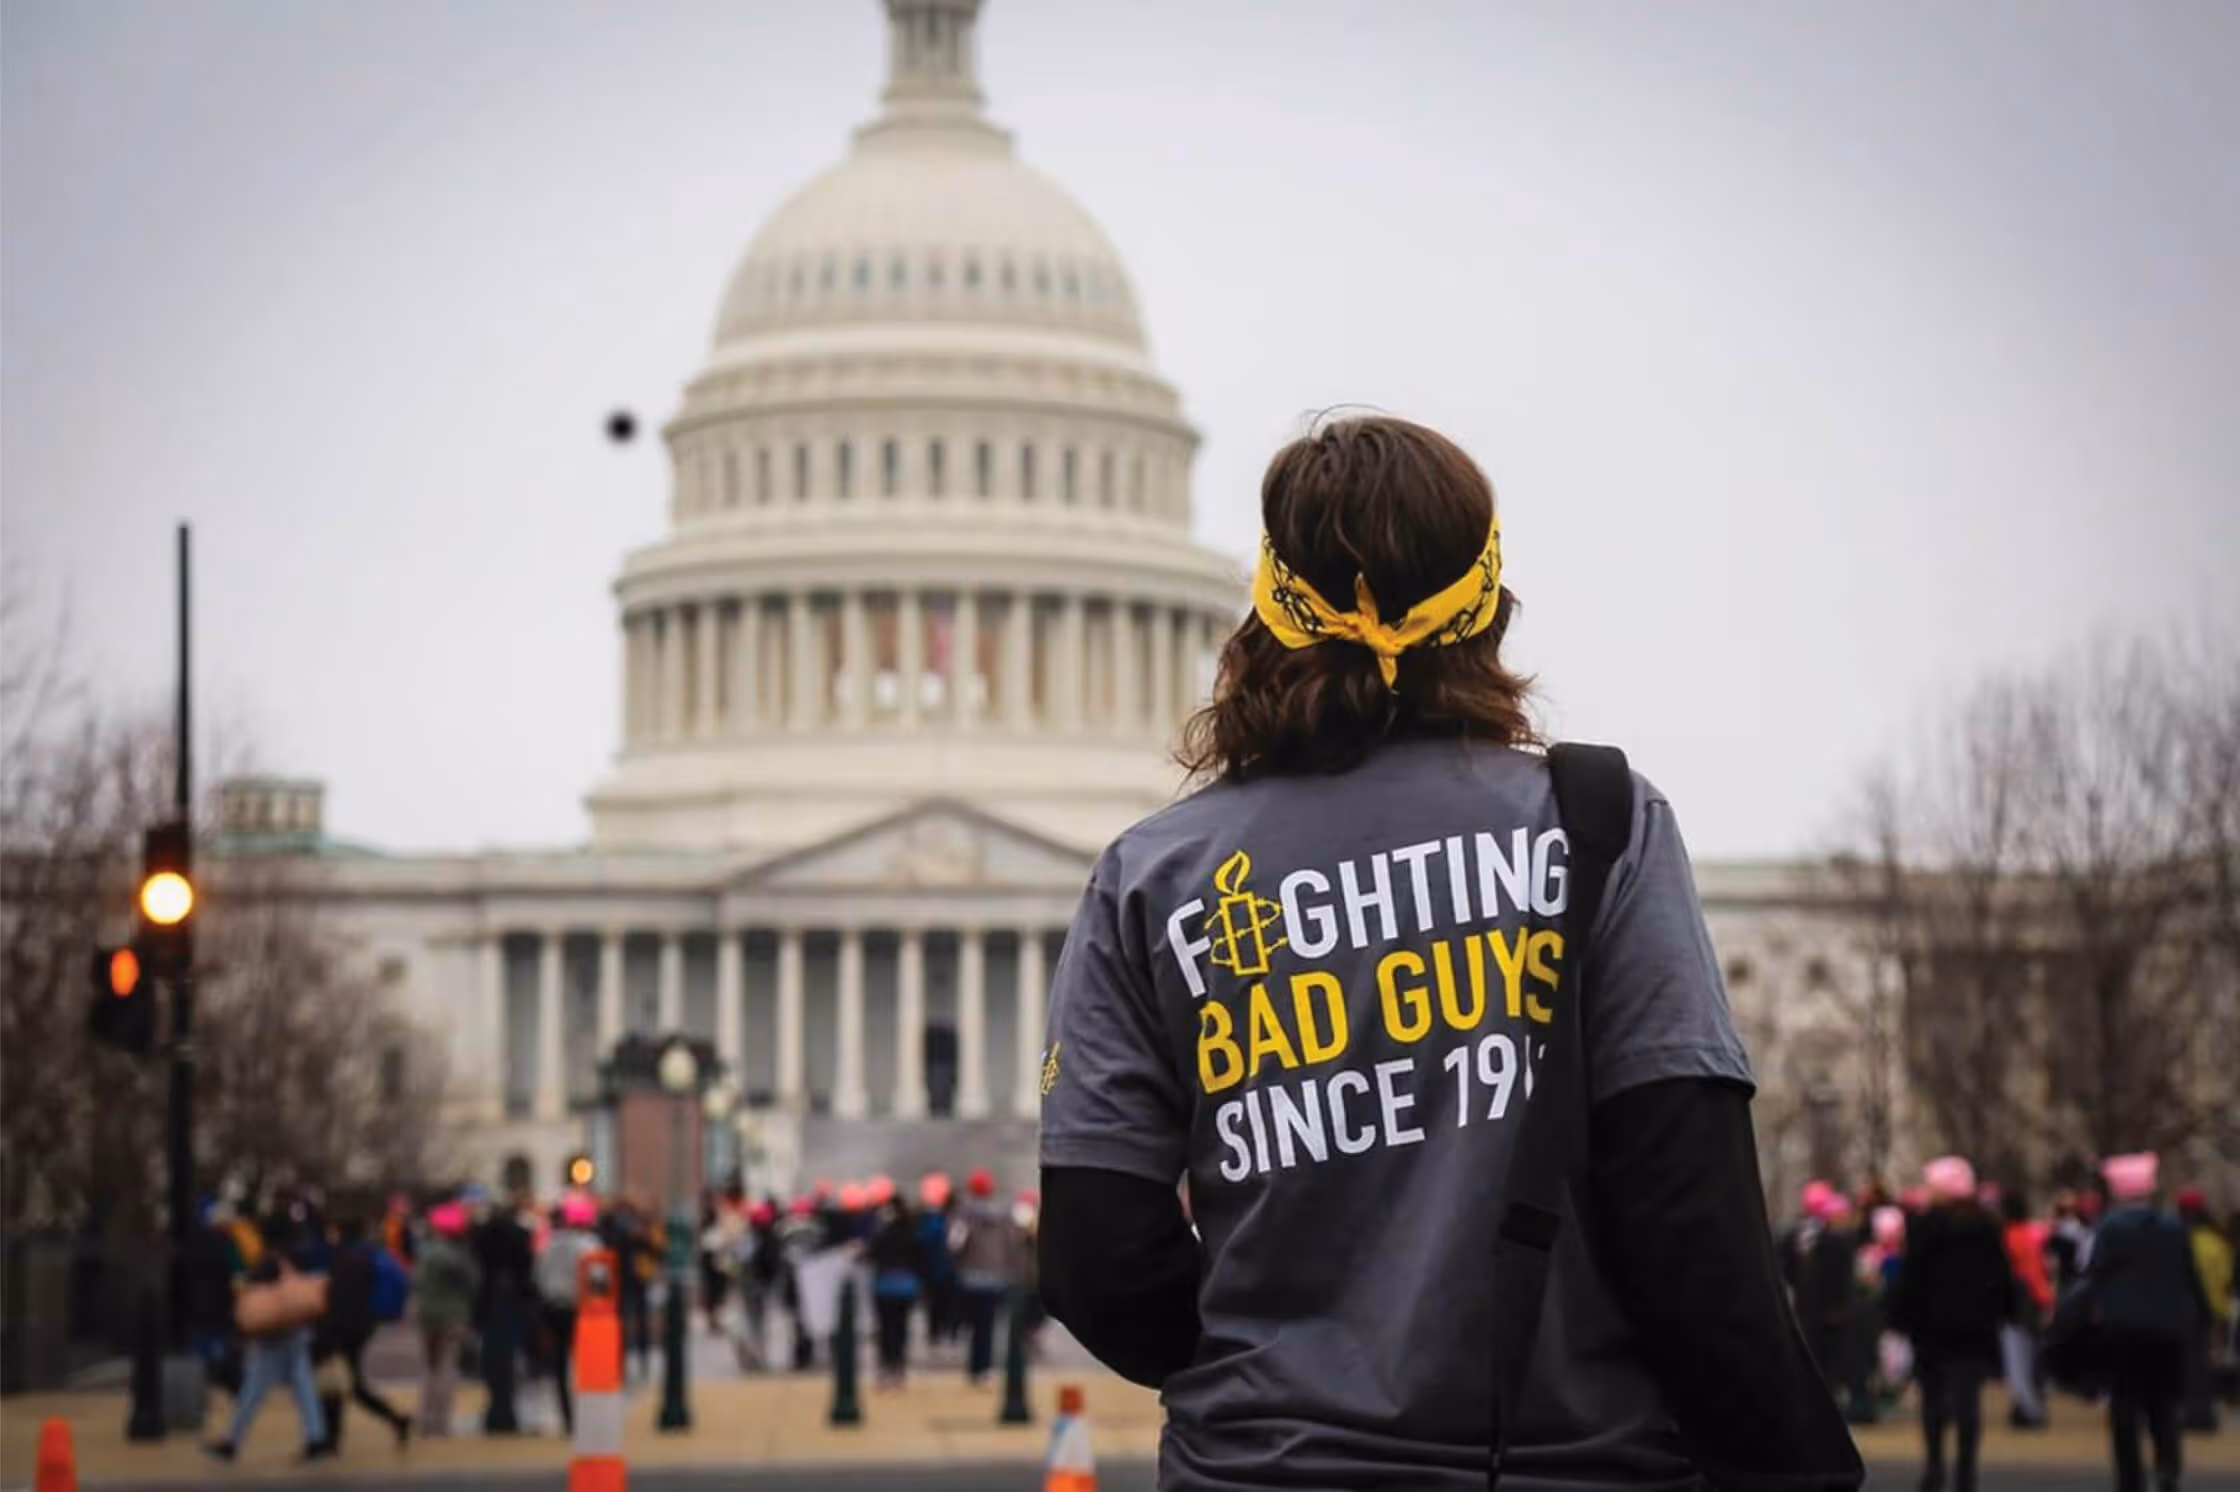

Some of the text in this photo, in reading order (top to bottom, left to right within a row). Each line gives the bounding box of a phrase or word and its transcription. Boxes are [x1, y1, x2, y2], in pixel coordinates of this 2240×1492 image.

[1197, 927, 1565, 1094] BAD GUYS
[1215, 1058, 1426, 1182] SINCE
